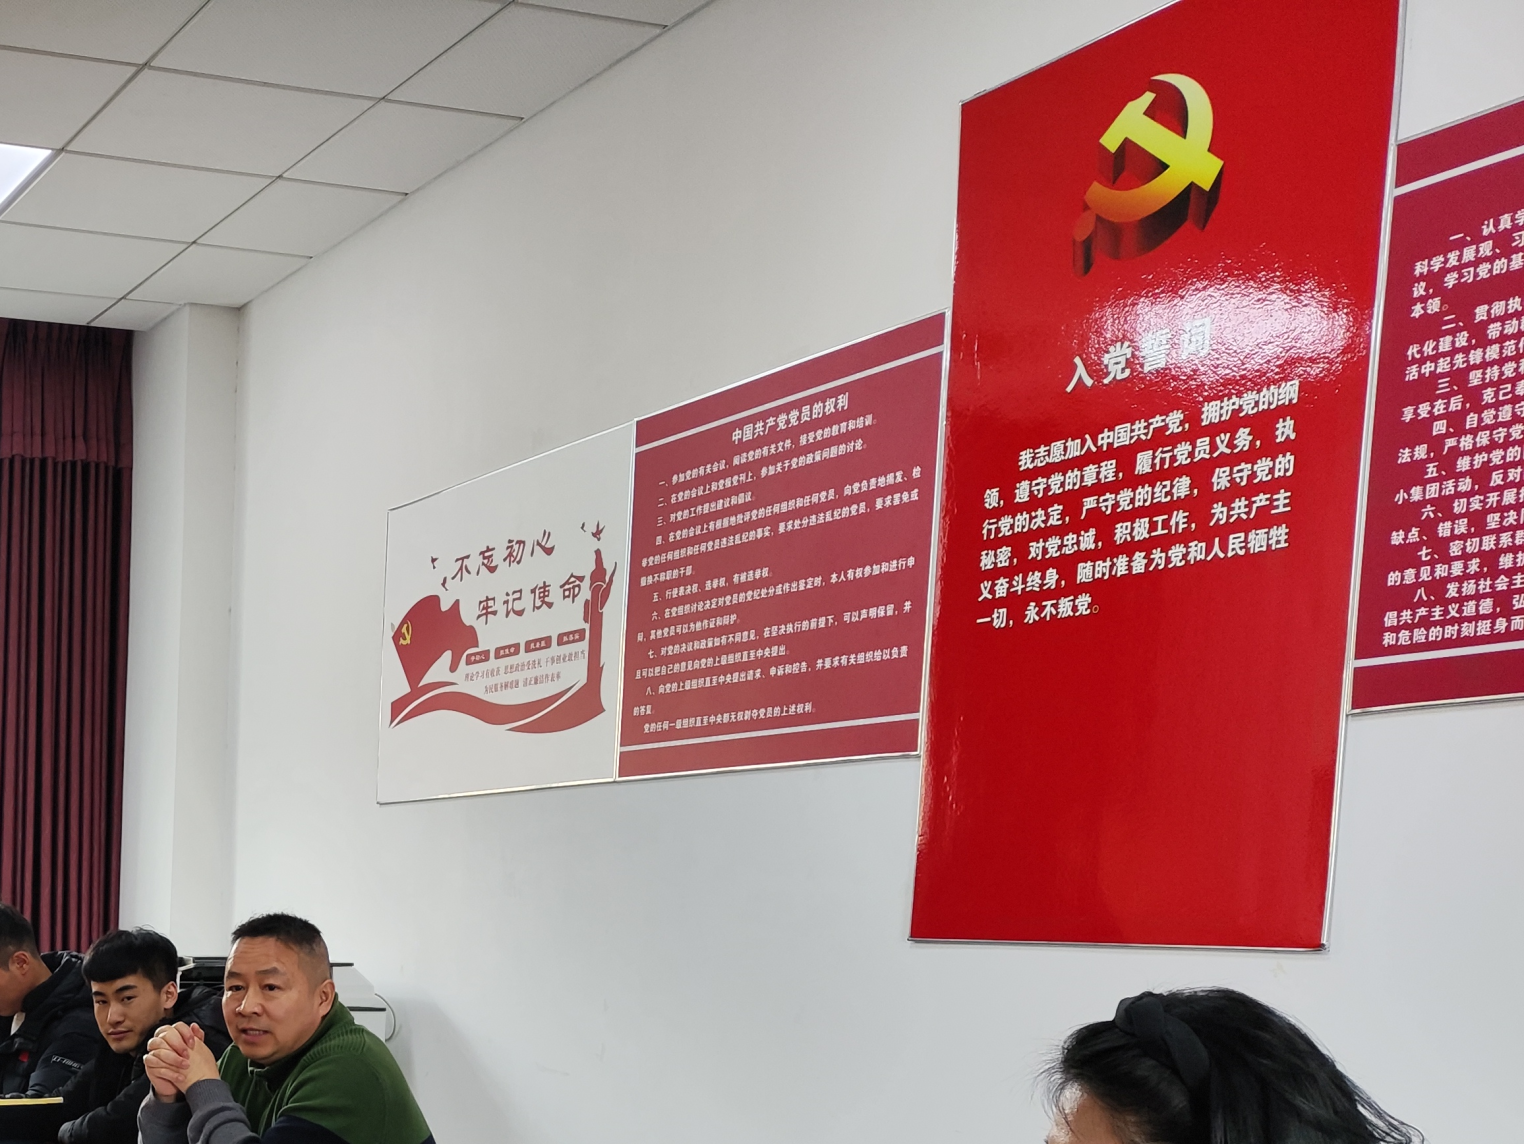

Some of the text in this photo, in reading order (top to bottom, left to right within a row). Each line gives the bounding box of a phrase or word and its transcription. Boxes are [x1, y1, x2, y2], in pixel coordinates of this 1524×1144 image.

[1411, 252, 1524, 298] 议，学习党的基
[1413, 230, 1524, 278] 科学发展观、习
[1409, 297, 1449, 319] 本领。
[1441, 295, 1523, 330] 二、贯彻执
[1064, 316, 1212, 394] 入党誓词
[731, 391, 850, 446] 中国共产党党员的权利
[1017, 379, 1300, 472] 我志愿加入中国共产党，拥护党的纲
[1397, 422, 1524, 465] 法规，严格保守党
[982, 416, 1297, 511] 领，遵守党的章程，履行党员义务，执
[1423, 444, 1524, 479] 五、维护党的
[981, 451, 1295, 541] 行党的决定，严守党的纪律，保守党的
[979, 488, 1292, 571] 秘密，对党忠诚，积极工作，为共产主
[1390, 507, 1524, 546] 缺点、错误，坚决
[451, 529, 556, 582] 不忘初心
[977, 523, 1290, 602] 义奋斗终身，随时准备为党和人民牺牲
[476, 572, 586, 625] 牢记使命
[976, 593, 1101, 630] 一切，永不叛党。
[1381, 614, 1524, 648] 和危险的时刻挺身而
